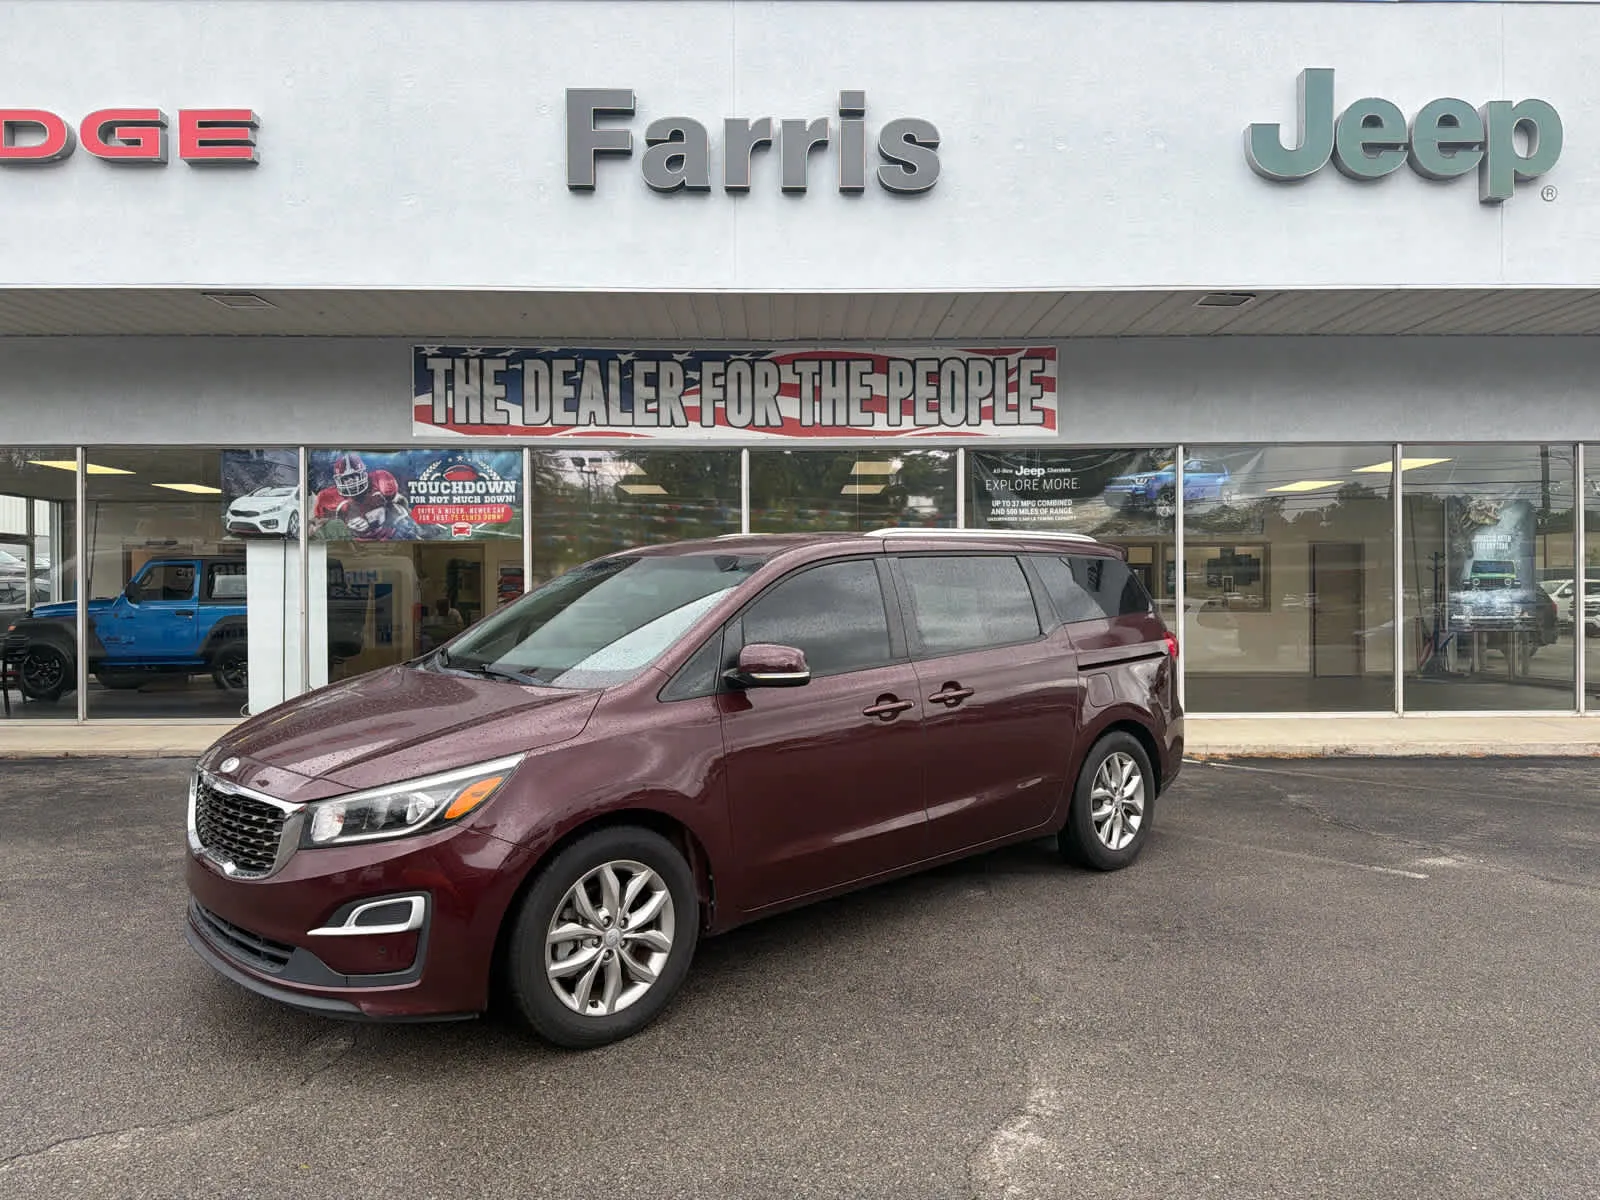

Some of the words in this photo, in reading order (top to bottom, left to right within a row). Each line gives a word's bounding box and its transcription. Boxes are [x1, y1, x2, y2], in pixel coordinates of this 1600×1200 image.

[565, 88, 940, 194] Farris
[1244, 68, 1564, 205] Jeep
[426, 357, 510, 426] THE
[521, 358, 689, 427] DEALER
[700, 358, 784, 427] FOR
[793, 357, 874, 427] THE
[886, 357, 1046, 427] PEOPLE
[1015, 465, 1045, 477] Jeep
[408, 480, 516, 494] TOUCHDOWN
[985, 479, 1039, 491] EXPLORE
[1043, 478, 1081, 490] MORE.
[410, 495, 426, 504] FOR
[429, 495, 449, 504] NOT
[452, 495, 481, 504] MUCH
[484, 495, 516, 504] DOWN!
